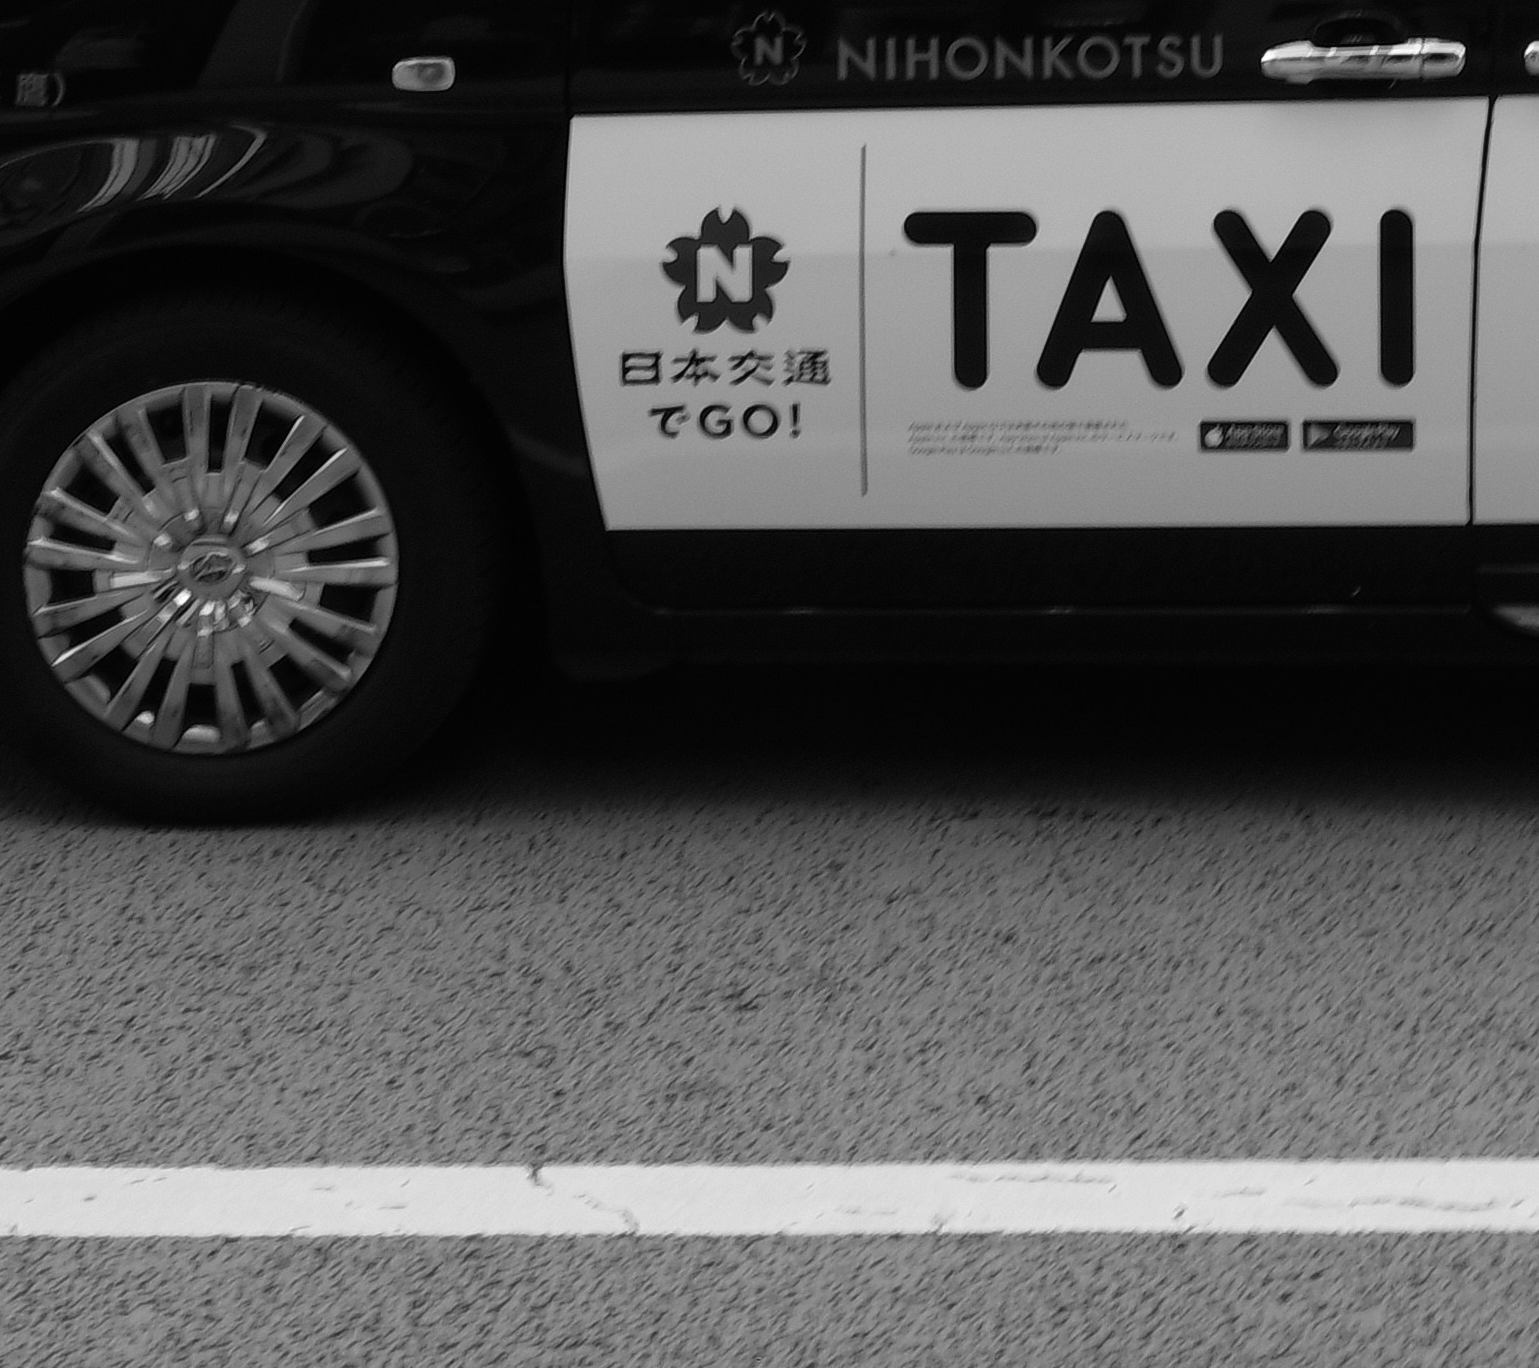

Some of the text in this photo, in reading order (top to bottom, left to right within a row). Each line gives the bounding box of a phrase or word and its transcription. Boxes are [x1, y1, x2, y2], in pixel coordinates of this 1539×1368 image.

[837, 34, 1226, 83] NIHONKOTSU
[903, 208, 1415, 391] TAXI
[619, 348, 832, 387] 日本交通
[647, 401, 802, 440] でGO!
